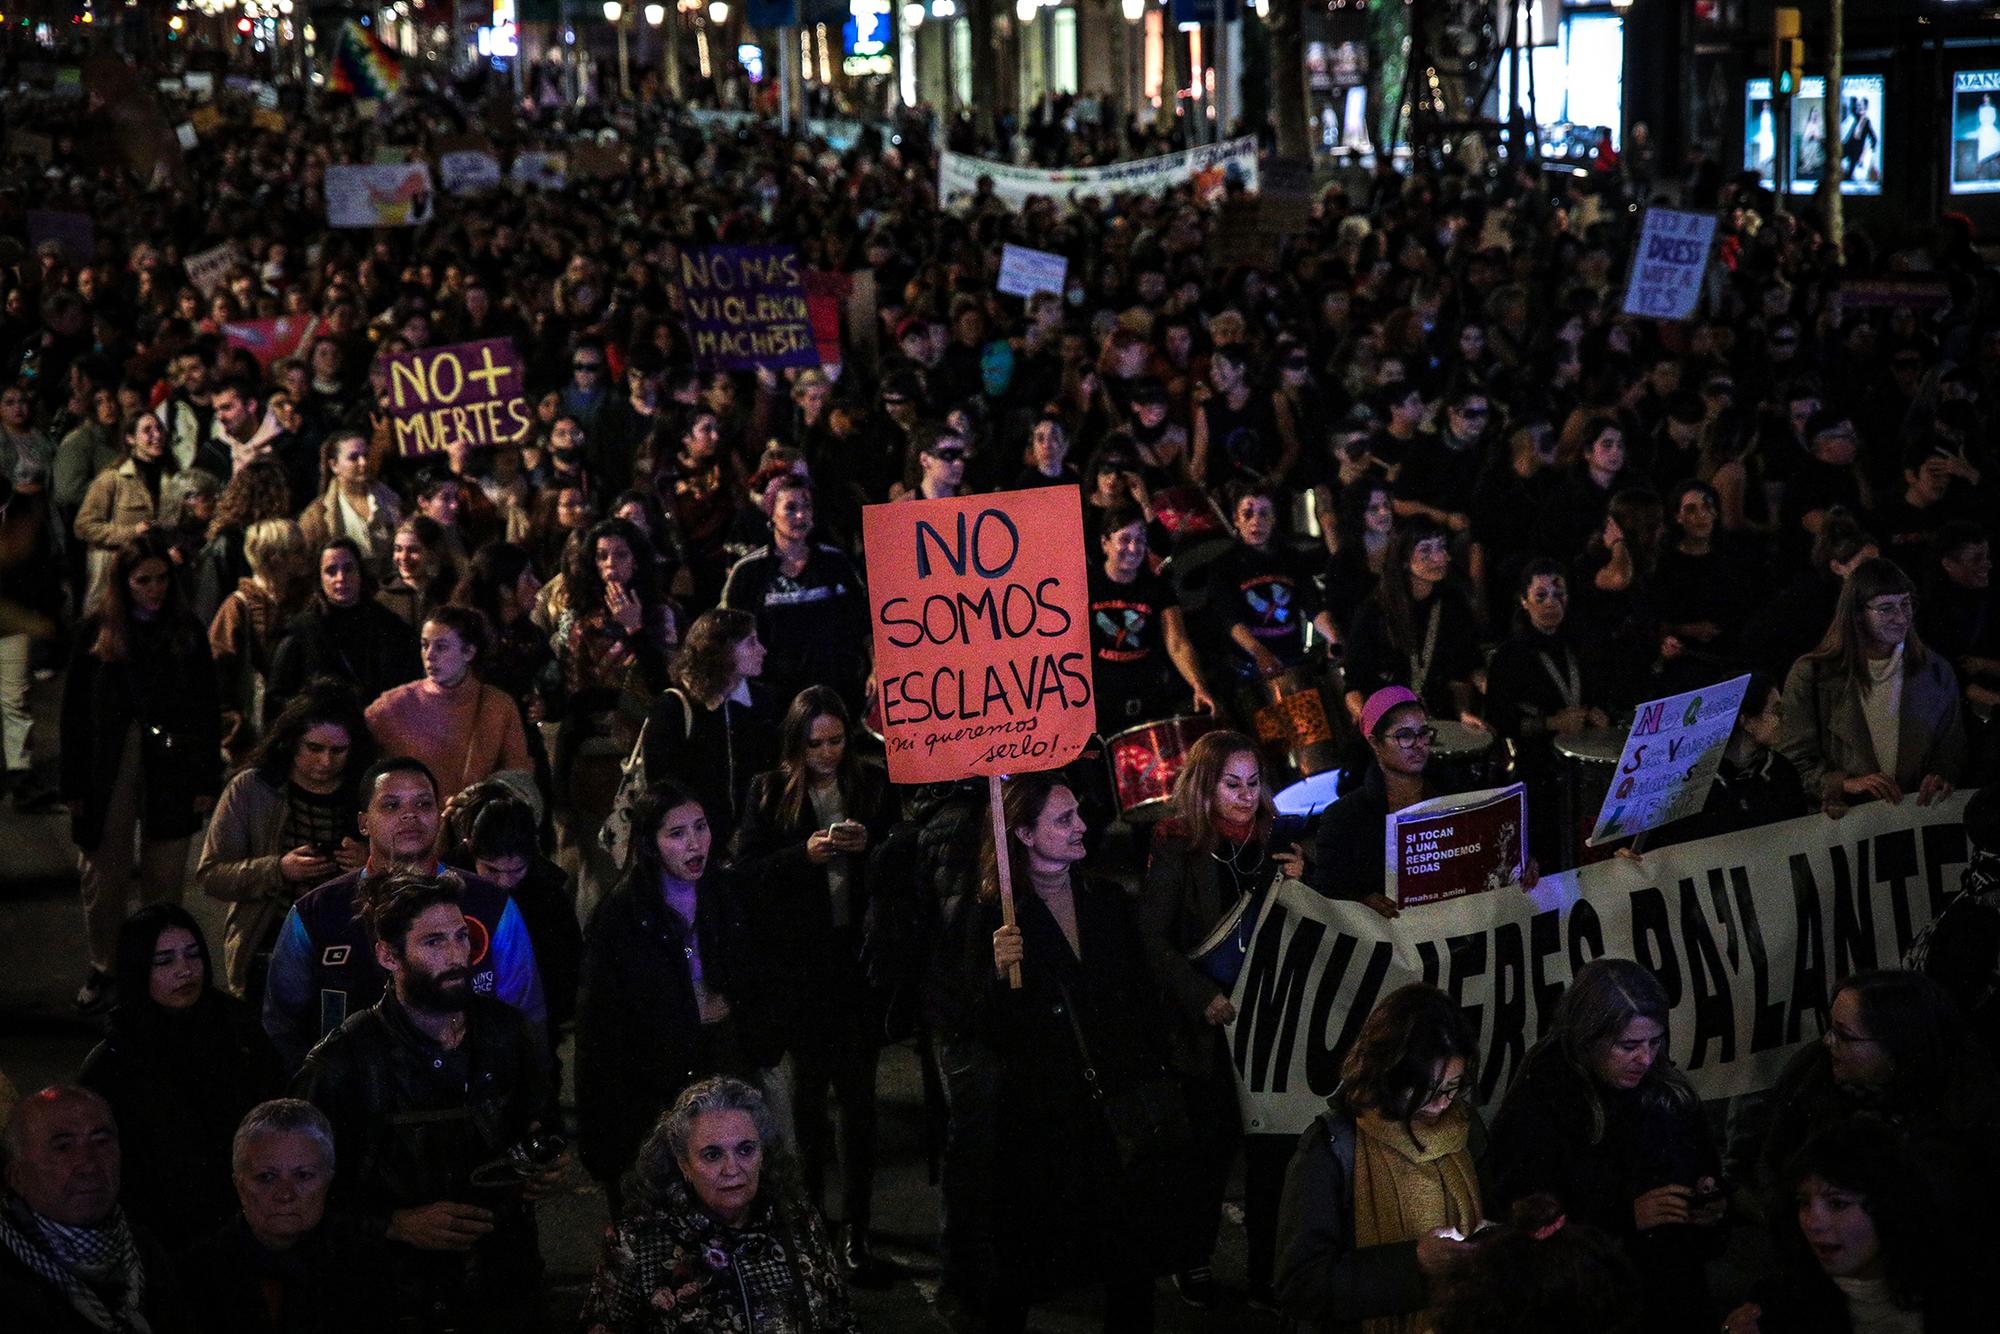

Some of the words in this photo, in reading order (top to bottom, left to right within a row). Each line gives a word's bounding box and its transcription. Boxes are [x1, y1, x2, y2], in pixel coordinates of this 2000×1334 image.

[1955, 73, 2000, 88] MAN
[1647, 234, 1702, 265] DRESS
[681, 252, 734, 290] NO
[394, 397, 530, 457] MUERTES
[916, 508, 1020, 580] NO
[880, 577, 1071, 648] SOMOS
[883, 652, 1091, 727] ESCLAVAS
[924, 716, 1038, 756] queremos
[1405, 845, 1414, 854] A
[1416, 841, 1439, 853] UNA
[1406, 834, 1417, 843] SI
[1419, 827, 1454, 841] TOCAN
[1405, 842, 1481, 865] RESPONDEMOS
[1405, 862, 1441, 875] TODAS
[1404, 888, 1467, 903] #mahsa_amini
